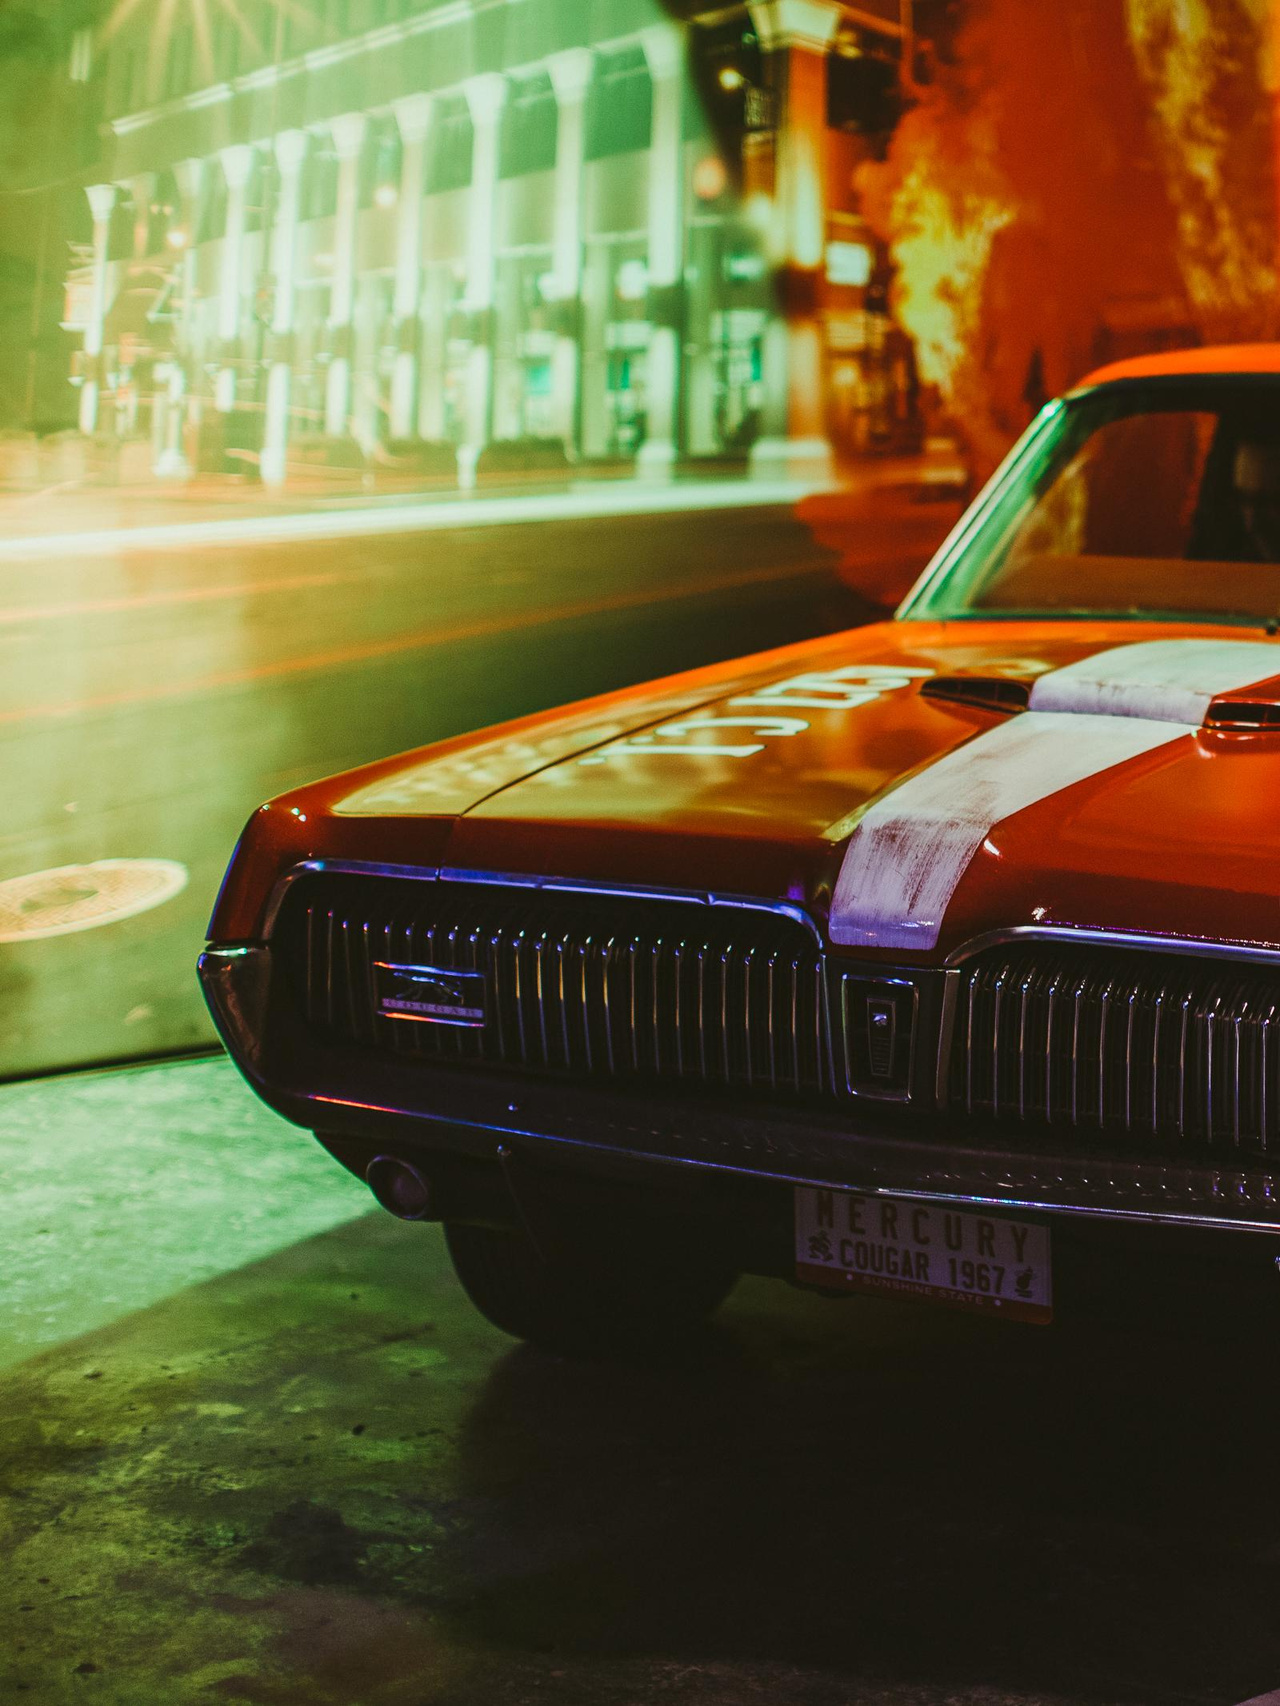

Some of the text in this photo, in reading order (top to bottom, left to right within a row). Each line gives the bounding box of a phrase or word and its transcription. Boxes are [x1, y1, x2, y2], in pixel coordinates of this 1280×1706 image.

[817, 1191, 1028, 1263] MERCURY
[840, 1239, 1005, 1295] COUGAR 1967
[863, 1276, 984, 1306] SUNSHINE STATE
